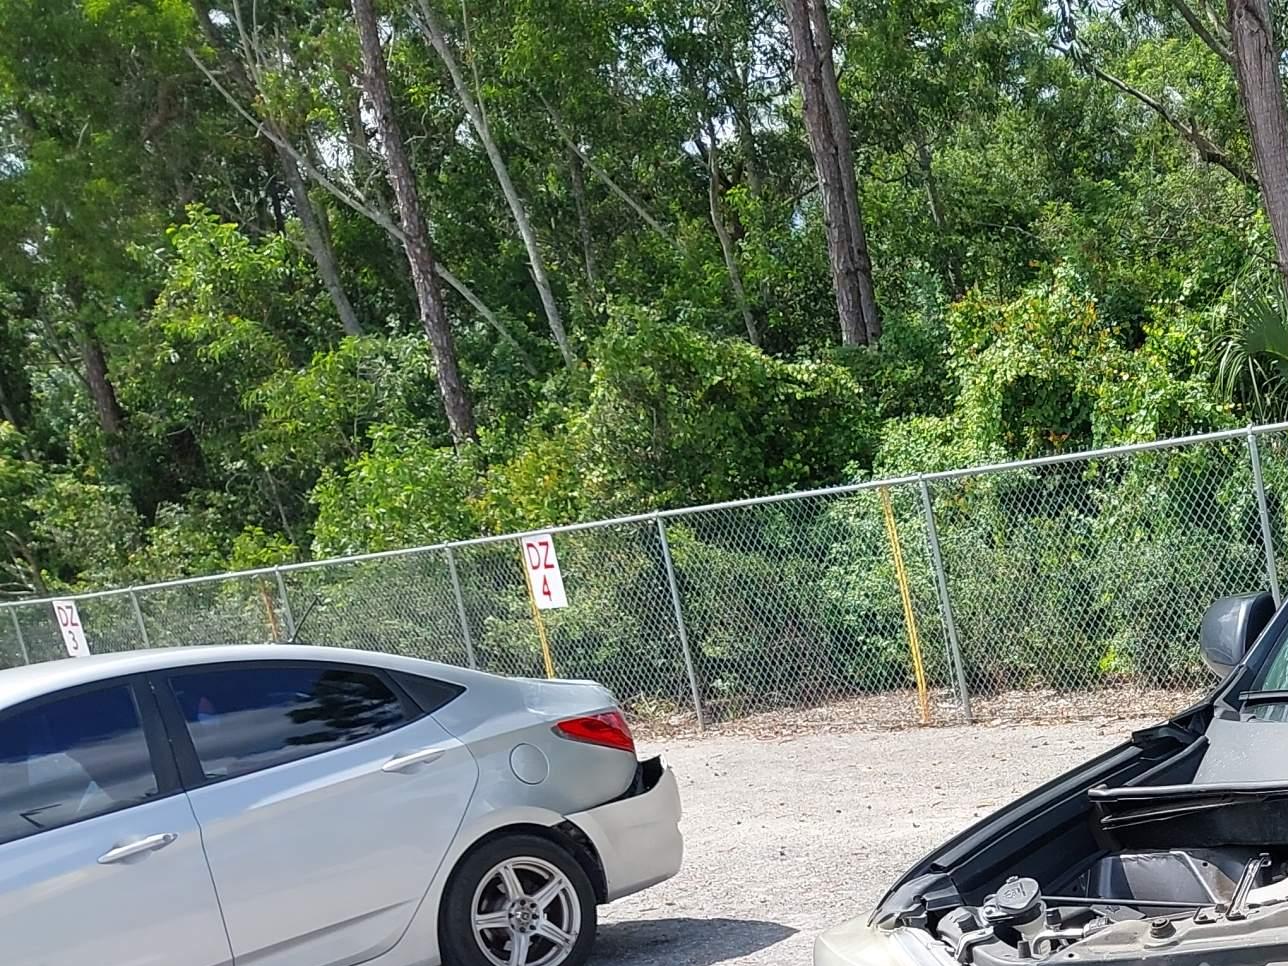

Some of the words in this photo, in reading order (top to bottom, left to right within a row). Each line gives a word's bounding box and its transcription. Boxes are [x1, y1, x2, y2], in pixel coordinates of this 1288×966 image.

[526, 541, 555, 570] DZ
[542, 574, 553, 602] 4
[57, 605, 80, 627] DZ
[68, 630, 79, 650] 3
